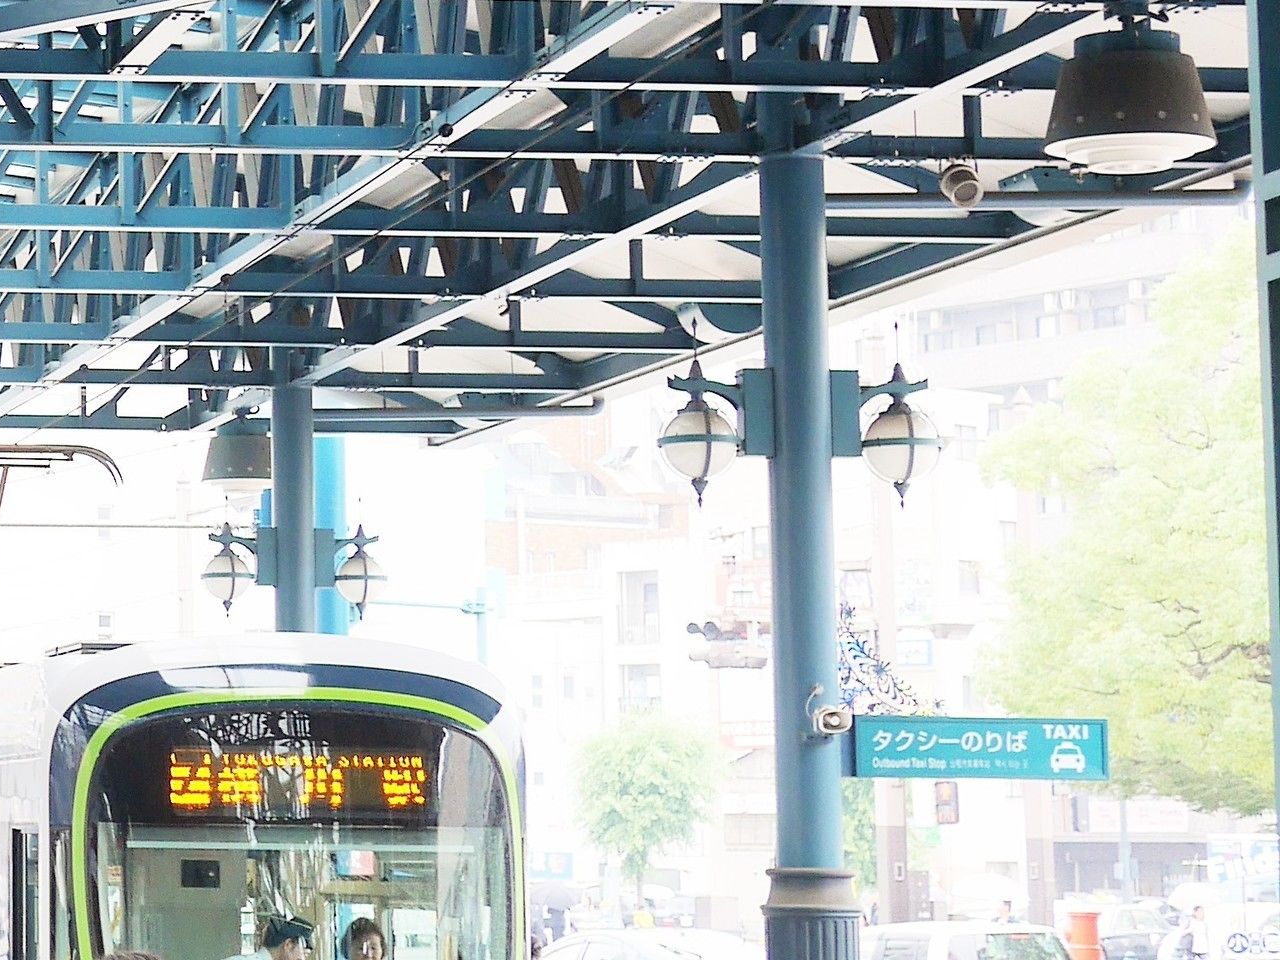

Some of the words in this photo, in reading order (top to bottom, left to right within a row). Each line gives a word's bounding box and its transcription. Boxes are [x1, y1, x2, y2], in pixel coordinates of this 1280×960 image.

[872, 729, 1029, 753] タクシーのりば
[1042, 723, 1089, 740] TAXI
